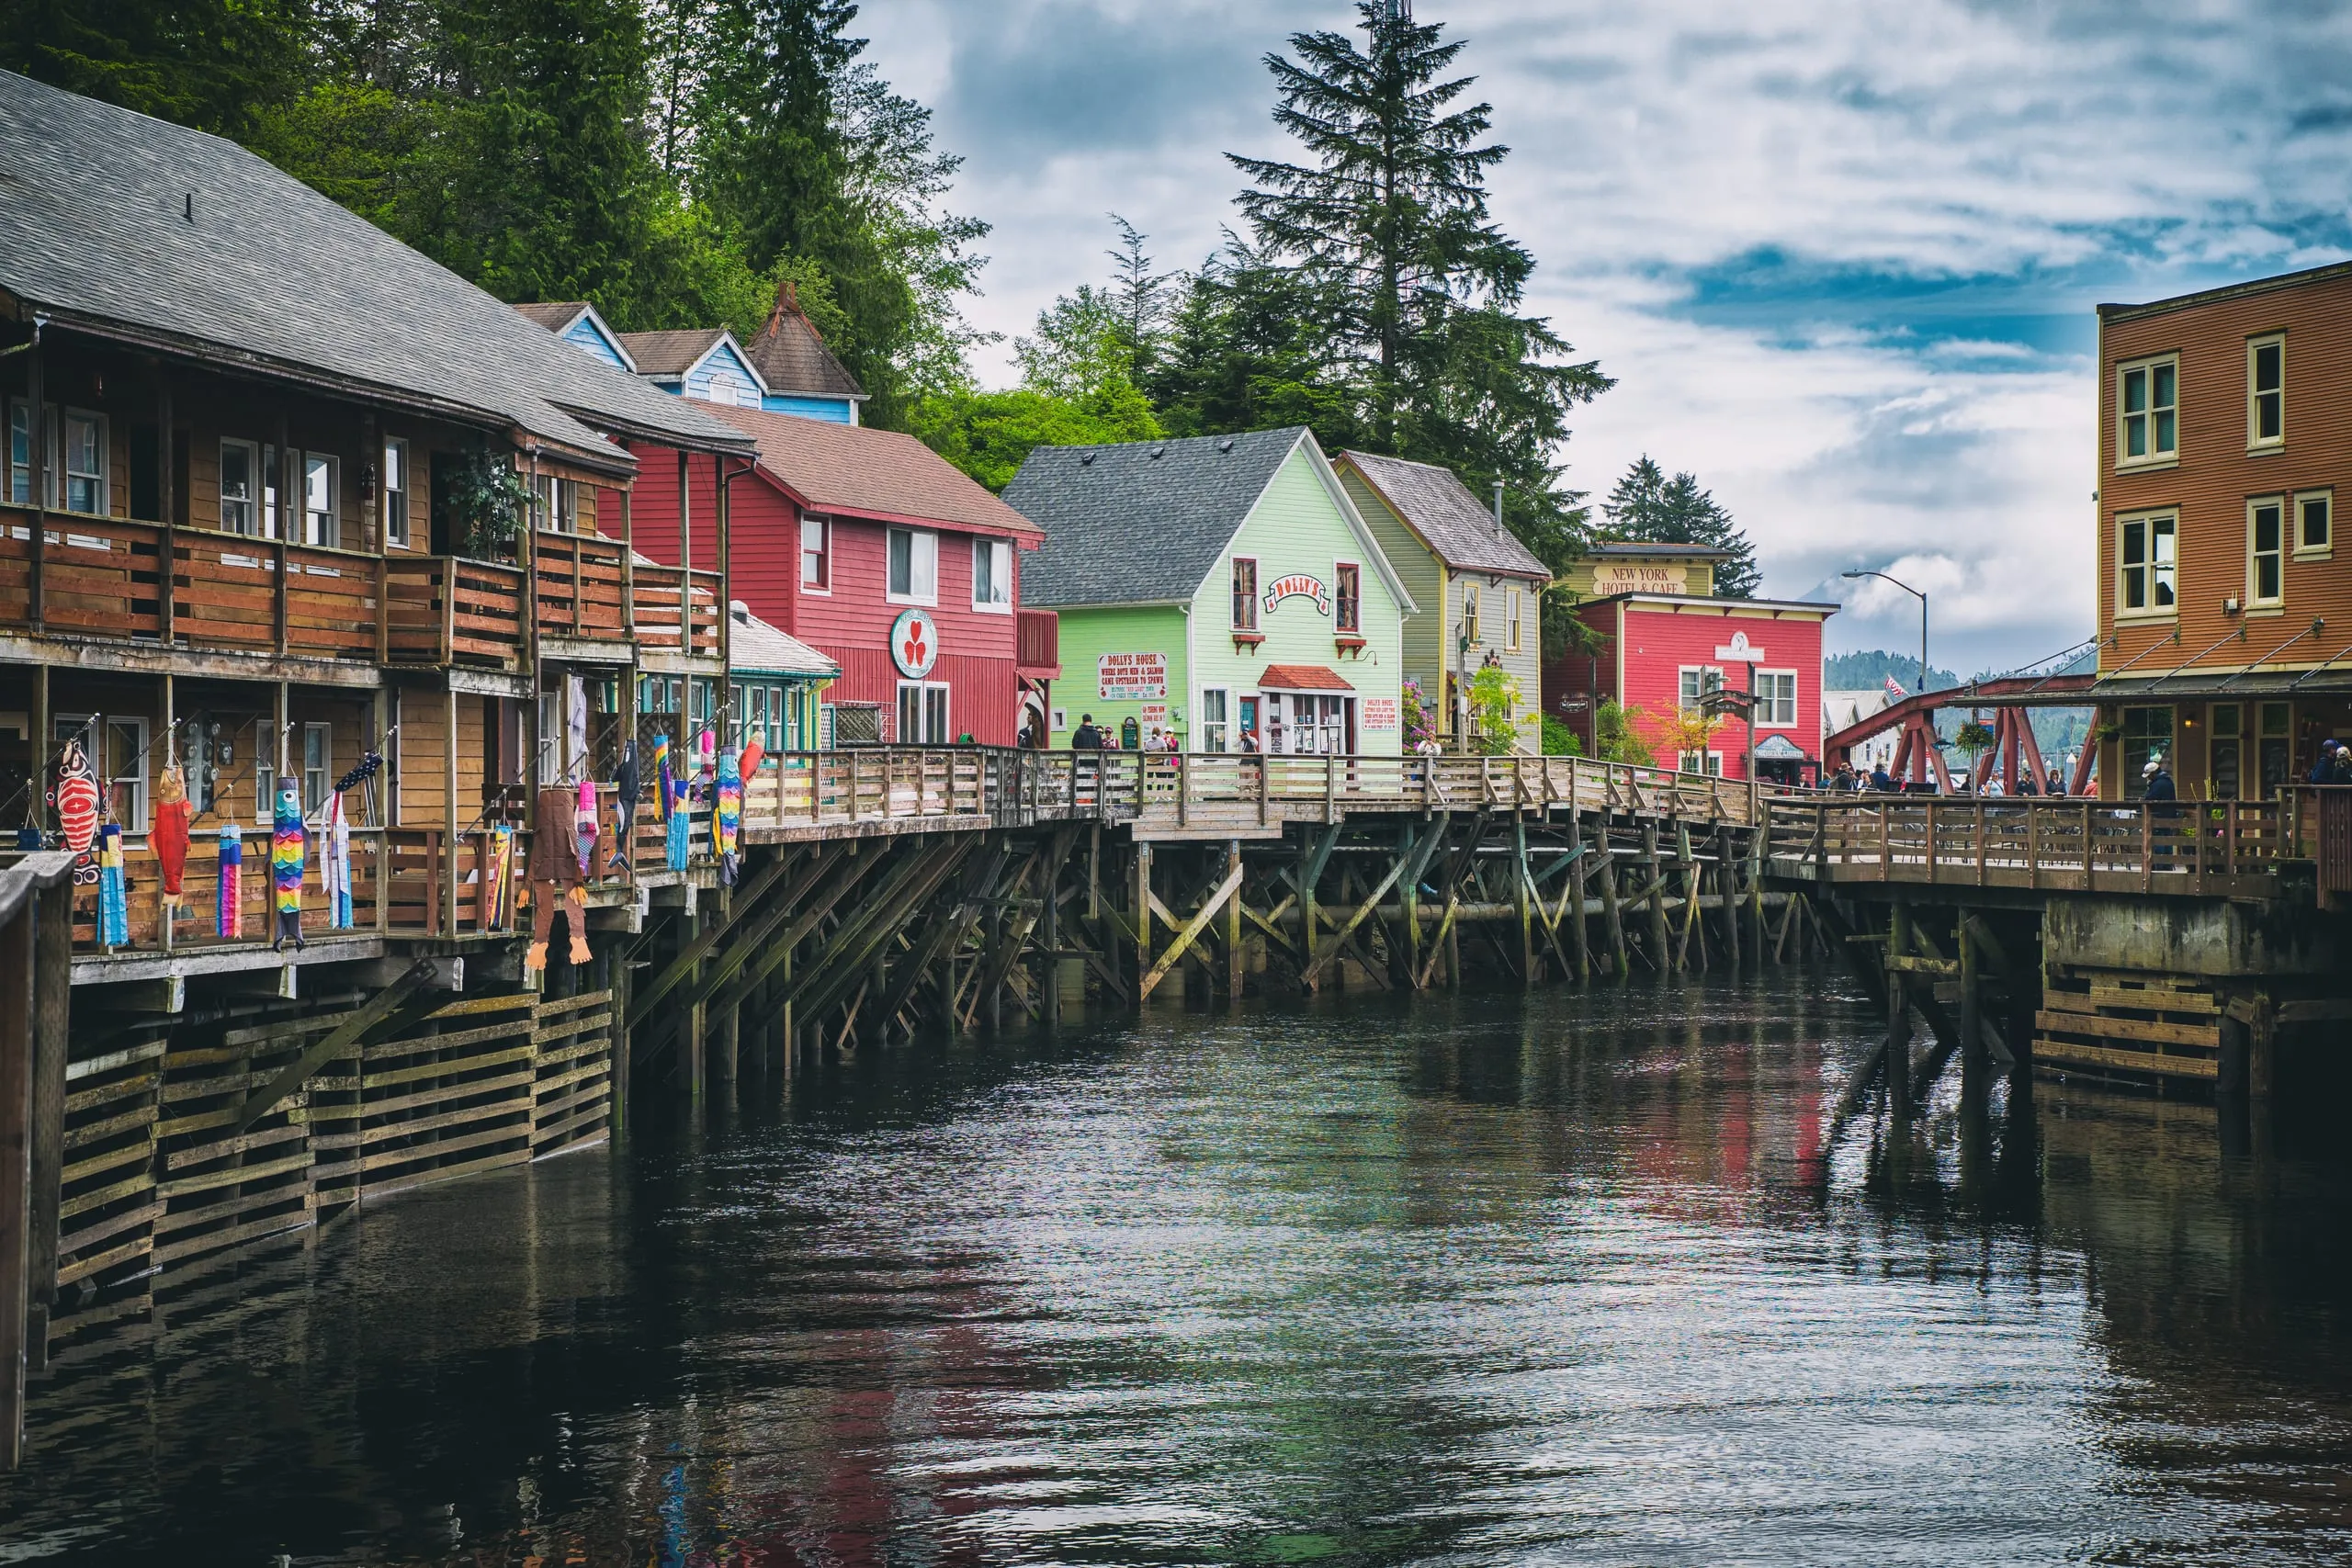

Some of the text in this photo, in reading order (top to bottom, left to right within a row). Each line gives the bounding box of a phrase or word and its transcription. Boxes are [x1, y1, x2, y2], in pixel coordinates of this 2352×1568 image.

[1612, 568, 1668, 581] NEW YORK
[1276, 578, 1319, 597] DOLLY'S
[1641, 582, 1648, 593] &
[1108, 654, 1157, 666] DOLLY'S HOUSE
[1102, 668, 1115, 676] WHERE
[1129, 667, 1138, 675] MEN
